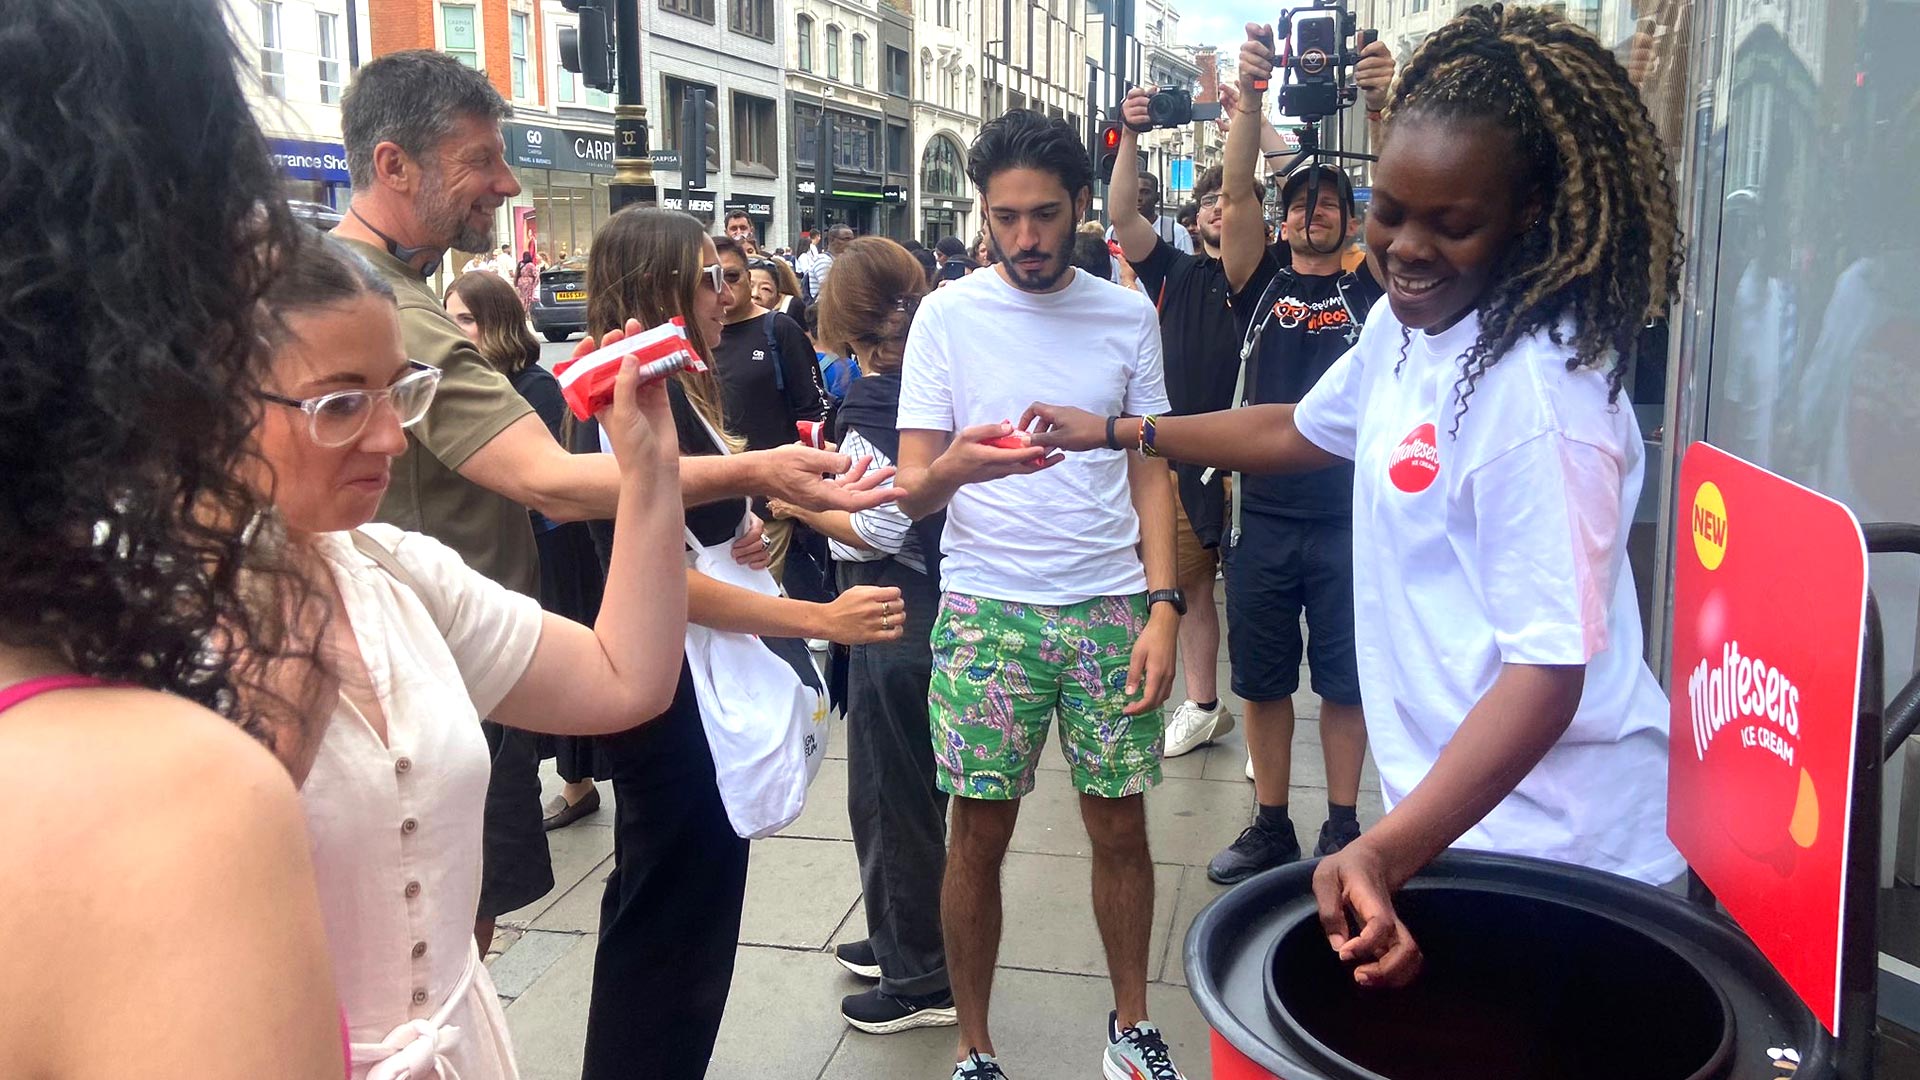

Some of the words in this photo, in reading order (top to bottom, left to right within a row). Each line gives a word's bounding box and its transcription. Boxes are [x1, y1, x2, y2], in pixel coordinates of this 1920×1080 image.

[526, 130, 542, 144] GO
[575, 138, 616, 160] CARPI
[323, 154, 348, 170] Sho
[663, 198, 713, 211] SKEHERS
[1389, 438, 1440, 469] Maltesers
[1694, 503, 1725, 548] NEW
[1688, 640, 1799, 761] Maltesers
[1741, 726, 1757, 748] ICE
[1757, 726, 1794, 767] CREAM
